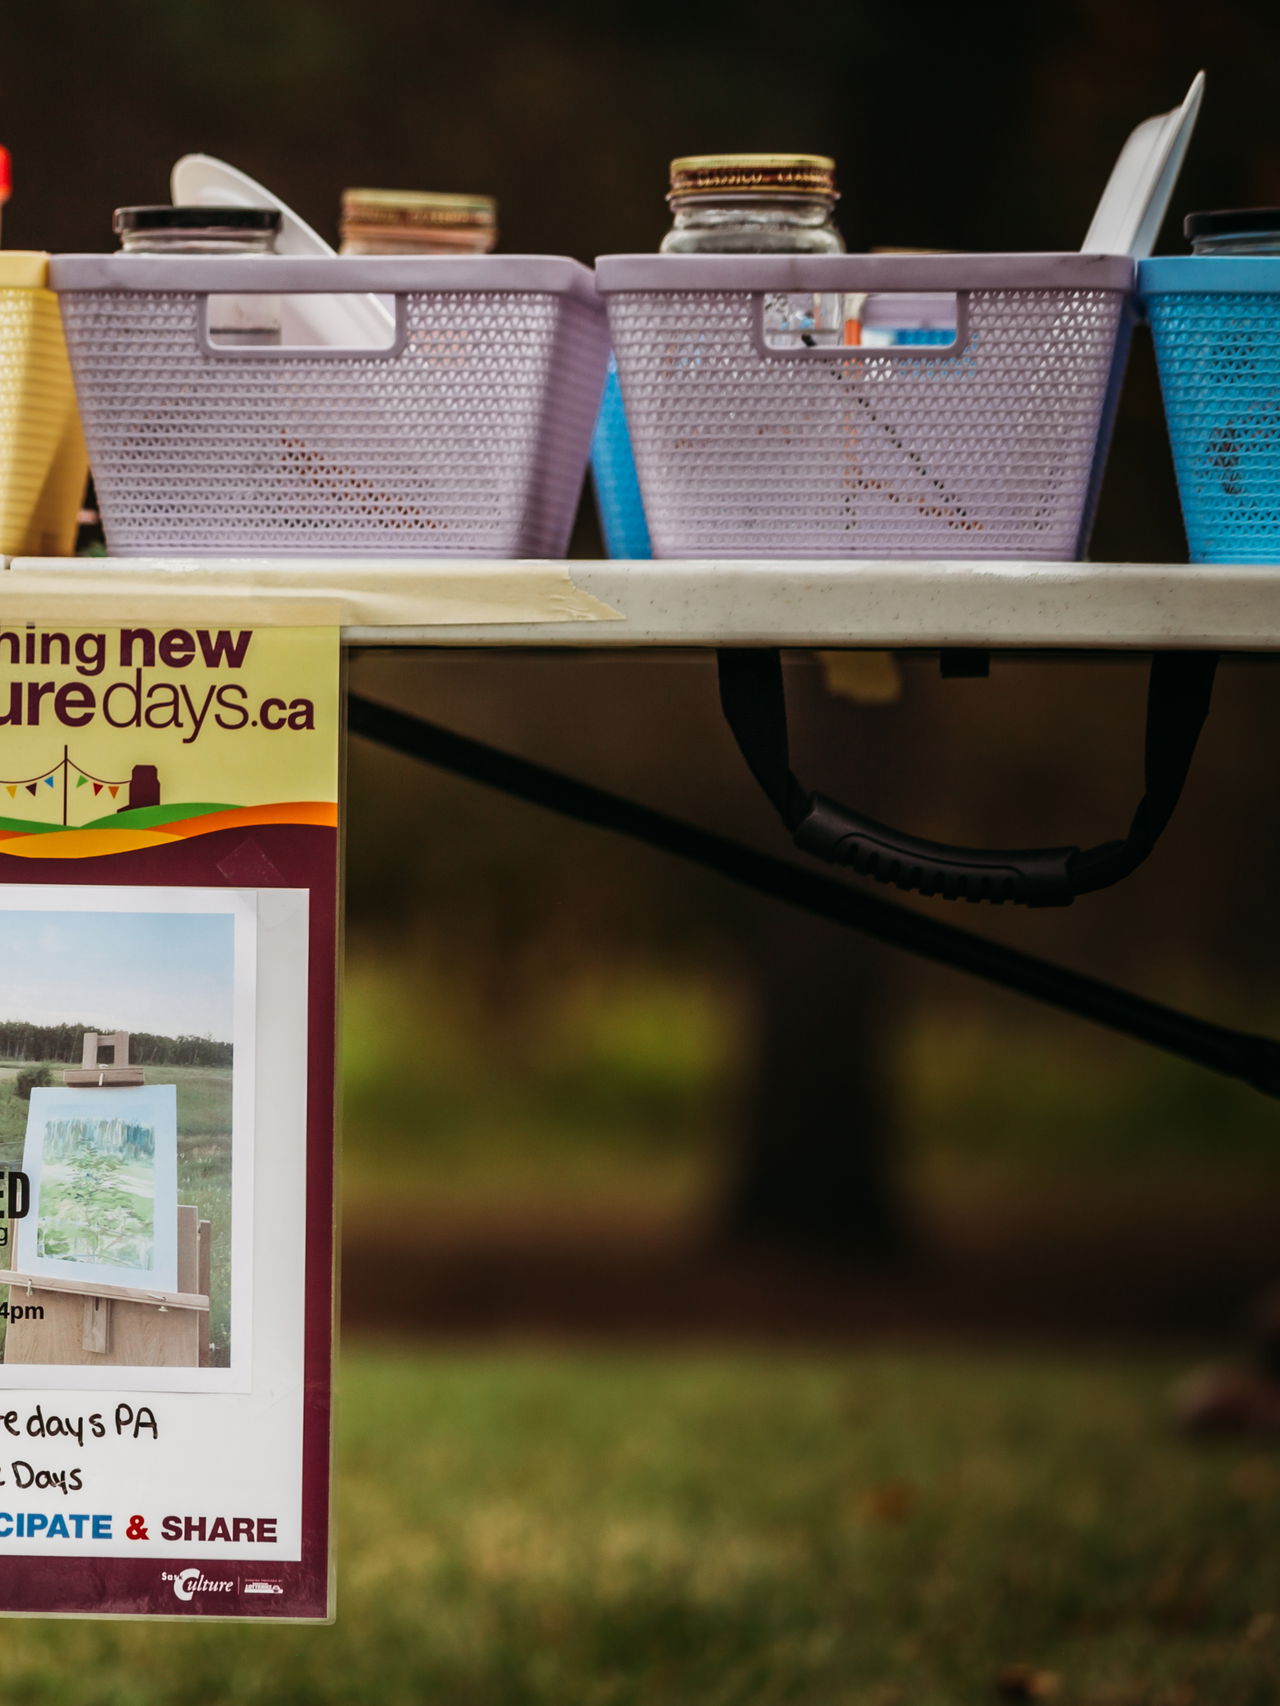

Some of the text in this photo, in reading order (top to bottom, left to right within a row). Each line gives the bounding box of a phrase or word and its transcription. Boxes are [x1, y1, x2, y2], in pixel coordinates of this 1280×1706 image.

[120, 628, 253, 668] new
[125, 1514, 151, 1541] &
[160, 1515, 278, 1543] SHARE
